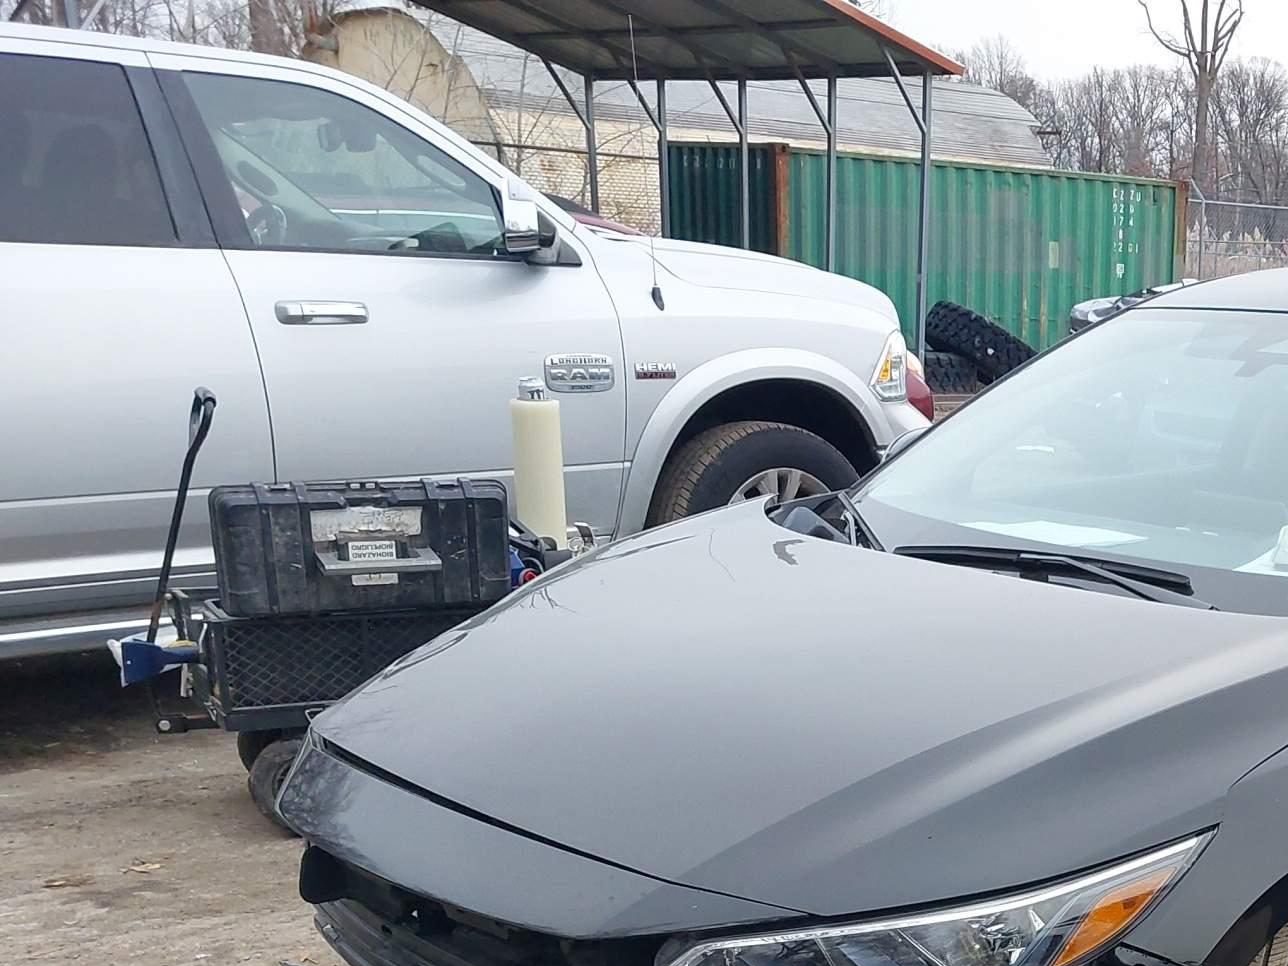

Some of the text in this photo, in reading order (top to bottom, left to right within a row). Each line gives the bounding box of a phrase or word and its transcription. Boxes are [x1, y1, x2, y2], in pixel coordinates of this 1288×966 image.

[634, 361, 677, 372] HEMI
[550, 367, 611, 381] RAM
[350, 543, 394, 551] BIOPELIGRO
[351, 551, 394, 559] BIOHAZARD
